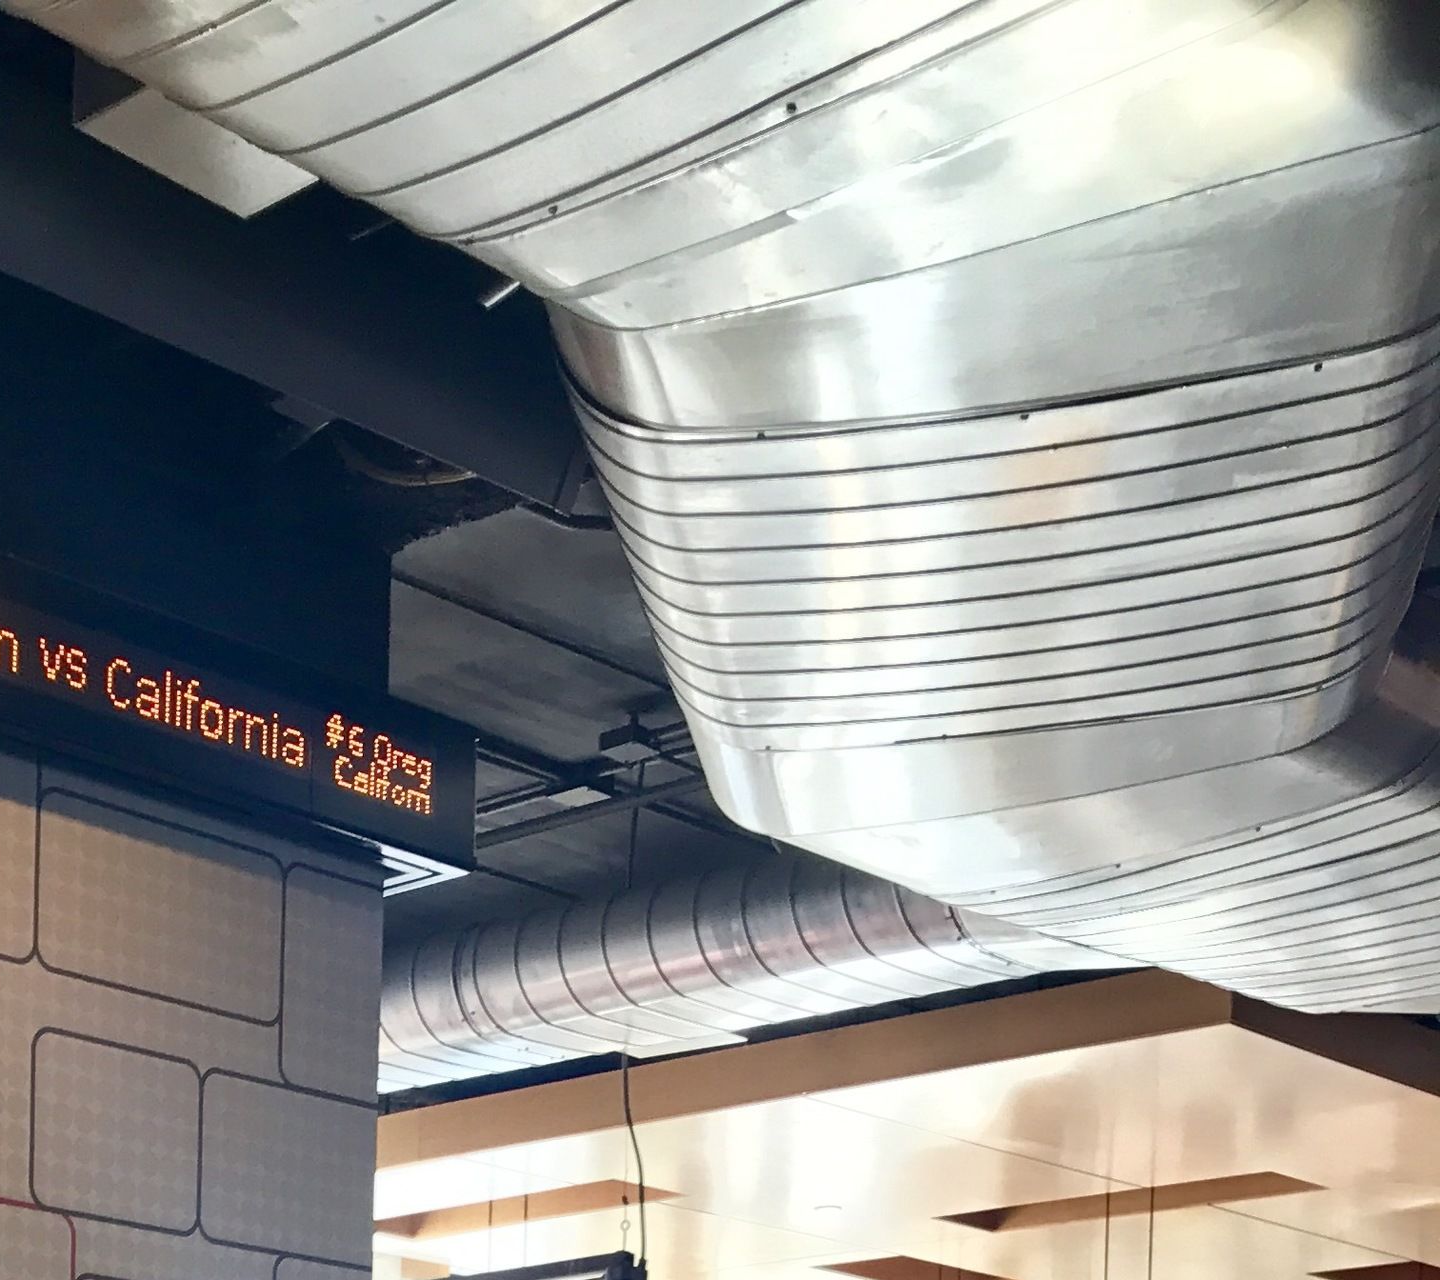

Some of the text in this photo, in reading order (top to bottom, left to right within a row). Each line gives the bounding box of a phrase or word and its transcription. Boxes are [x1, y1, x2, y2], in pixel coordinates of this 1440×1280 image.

[39, 637, 87, 689] vs
[107, 656, 305, 768] California
[326, 713, 364, 757] #6
